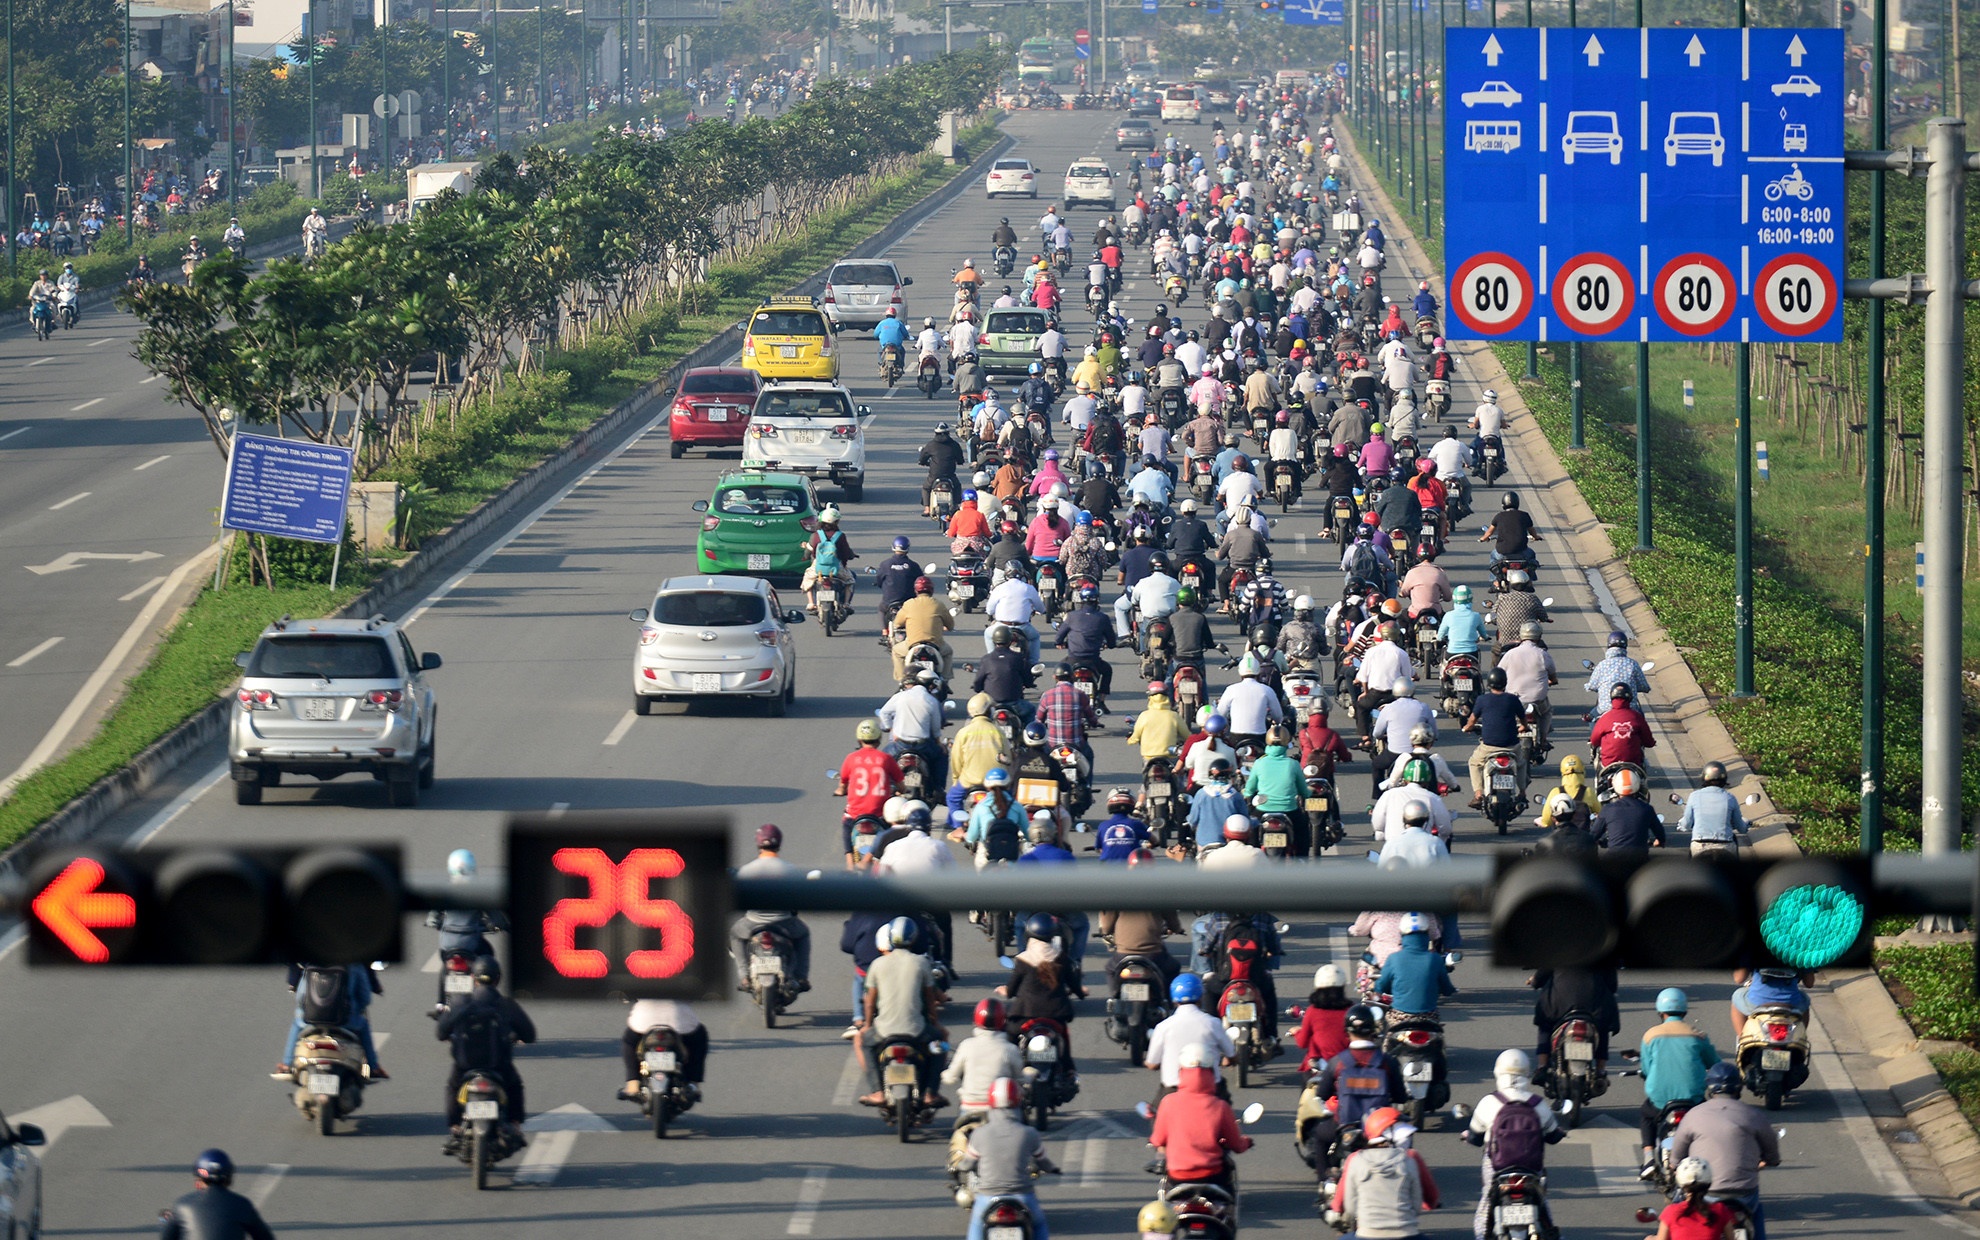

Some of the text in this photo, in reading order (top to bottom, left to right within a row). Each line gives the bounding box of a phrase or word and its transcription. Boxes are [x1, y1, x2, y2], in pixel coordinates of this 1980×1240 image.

[1475, 276, 1509, 312] 80
[1576, 275, 1610, 311] 80
[1678, 276, 1712, 312] 80
[1778, 277, 1812, 313] 60
[854, 766, 886, 797] 32
[1020, 764, 1050, 773] adidas
[543, 848, 694, 978] 25
